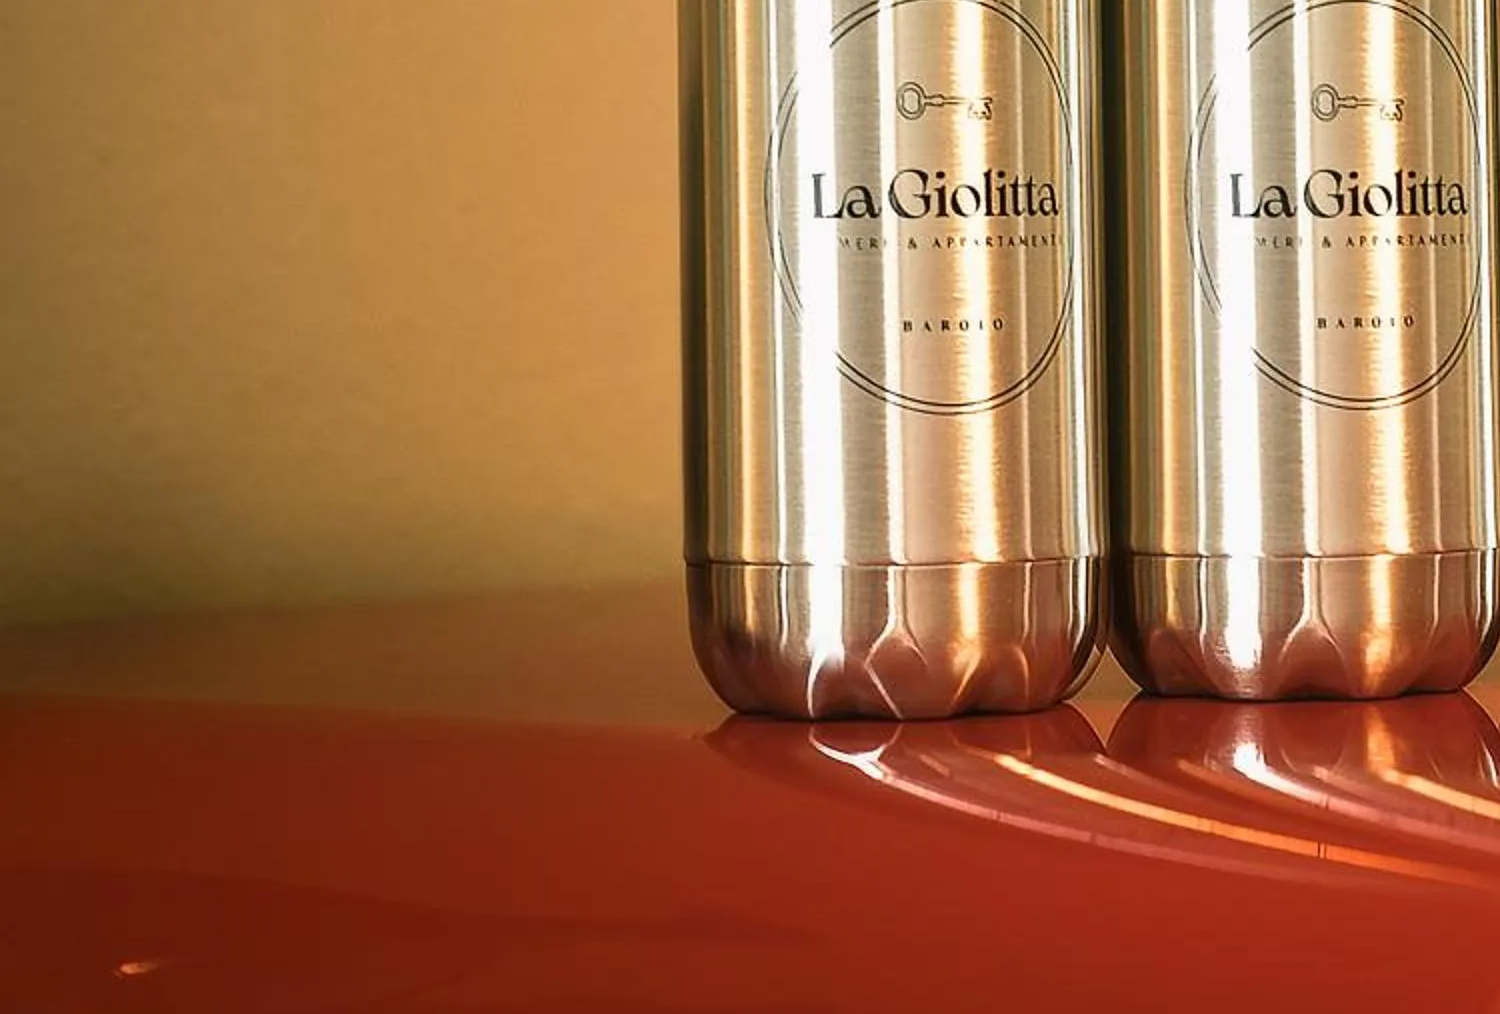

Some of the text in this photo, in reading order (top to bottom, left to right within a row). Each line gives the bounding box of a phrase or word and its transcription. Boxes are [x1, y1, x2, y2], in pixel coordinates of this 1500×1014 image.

[811, 168, 1059, 219] La Giolitta
[1229, 169, 1469, 218] La Giolitta
